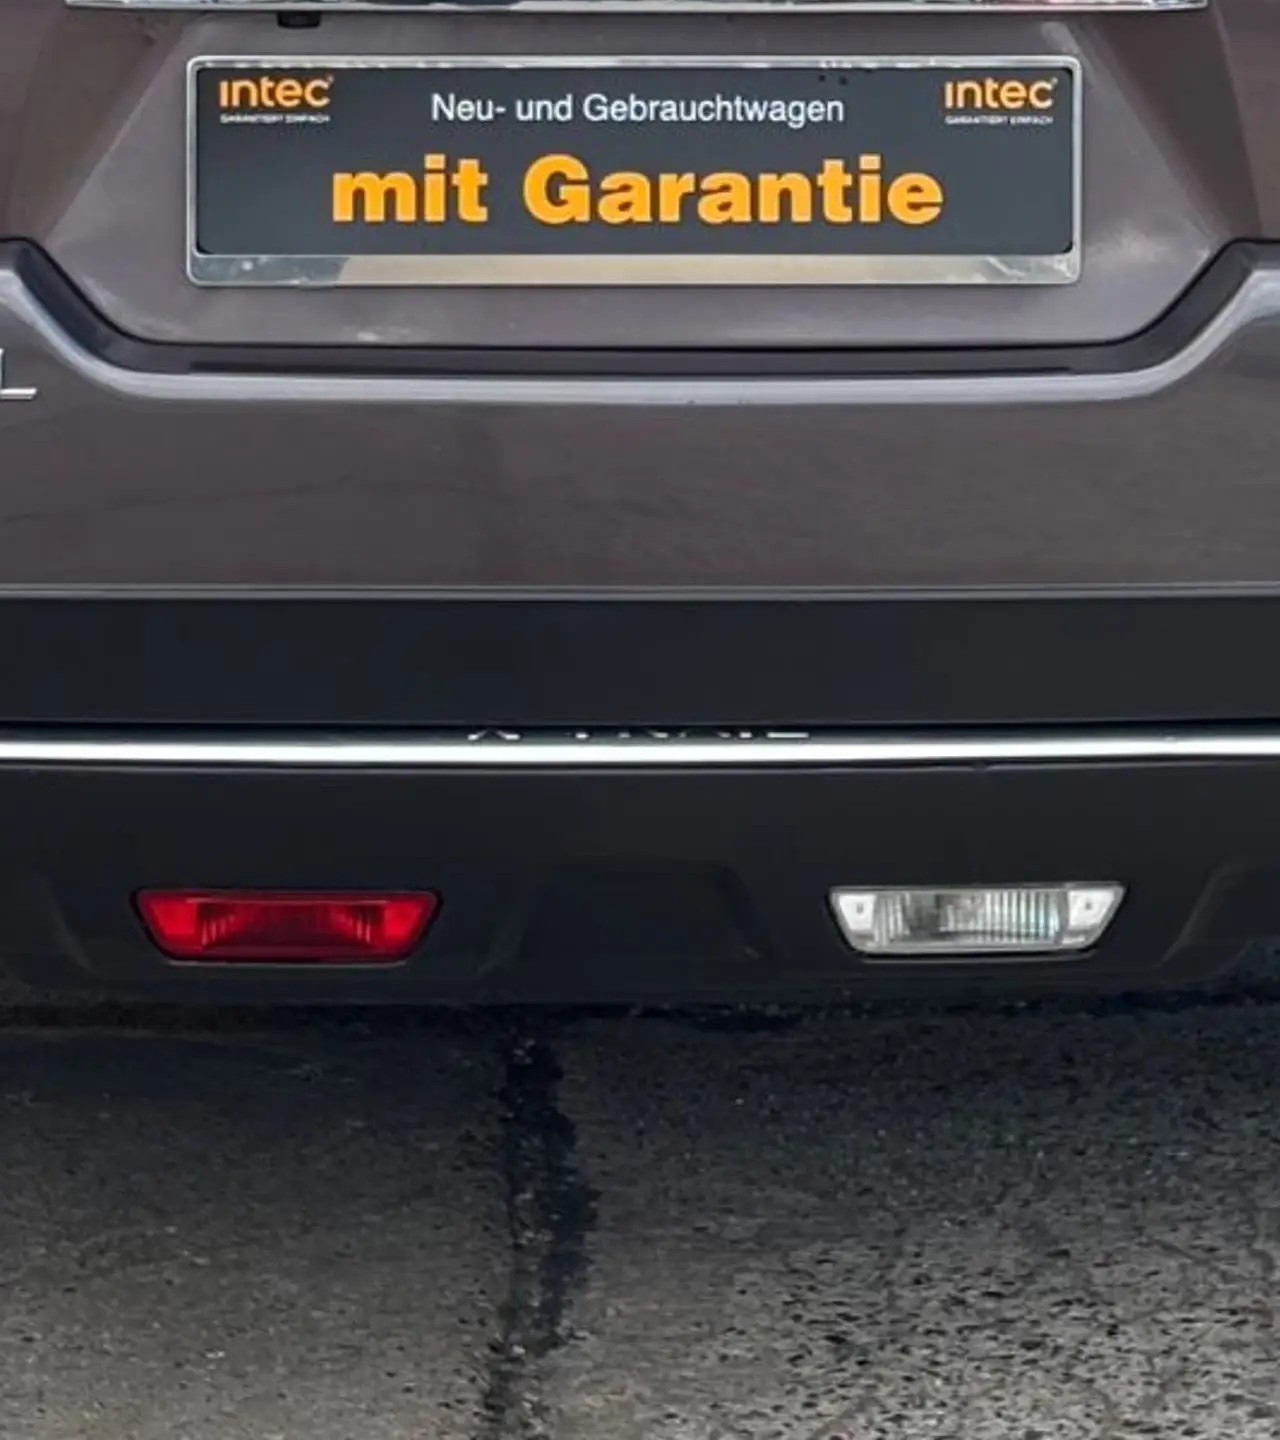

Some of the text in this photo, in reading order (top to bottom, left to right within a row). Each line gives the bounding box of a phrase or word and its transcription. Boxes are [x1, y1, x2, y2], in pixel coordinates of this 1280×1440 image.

[219, 75, 332, 108] intec
[944, 76, 1055, 109] intec
[431, 92, 845, 129] Neu- und Gebrauchtwagen
[332, 153, 944, 225] mit Garantie
